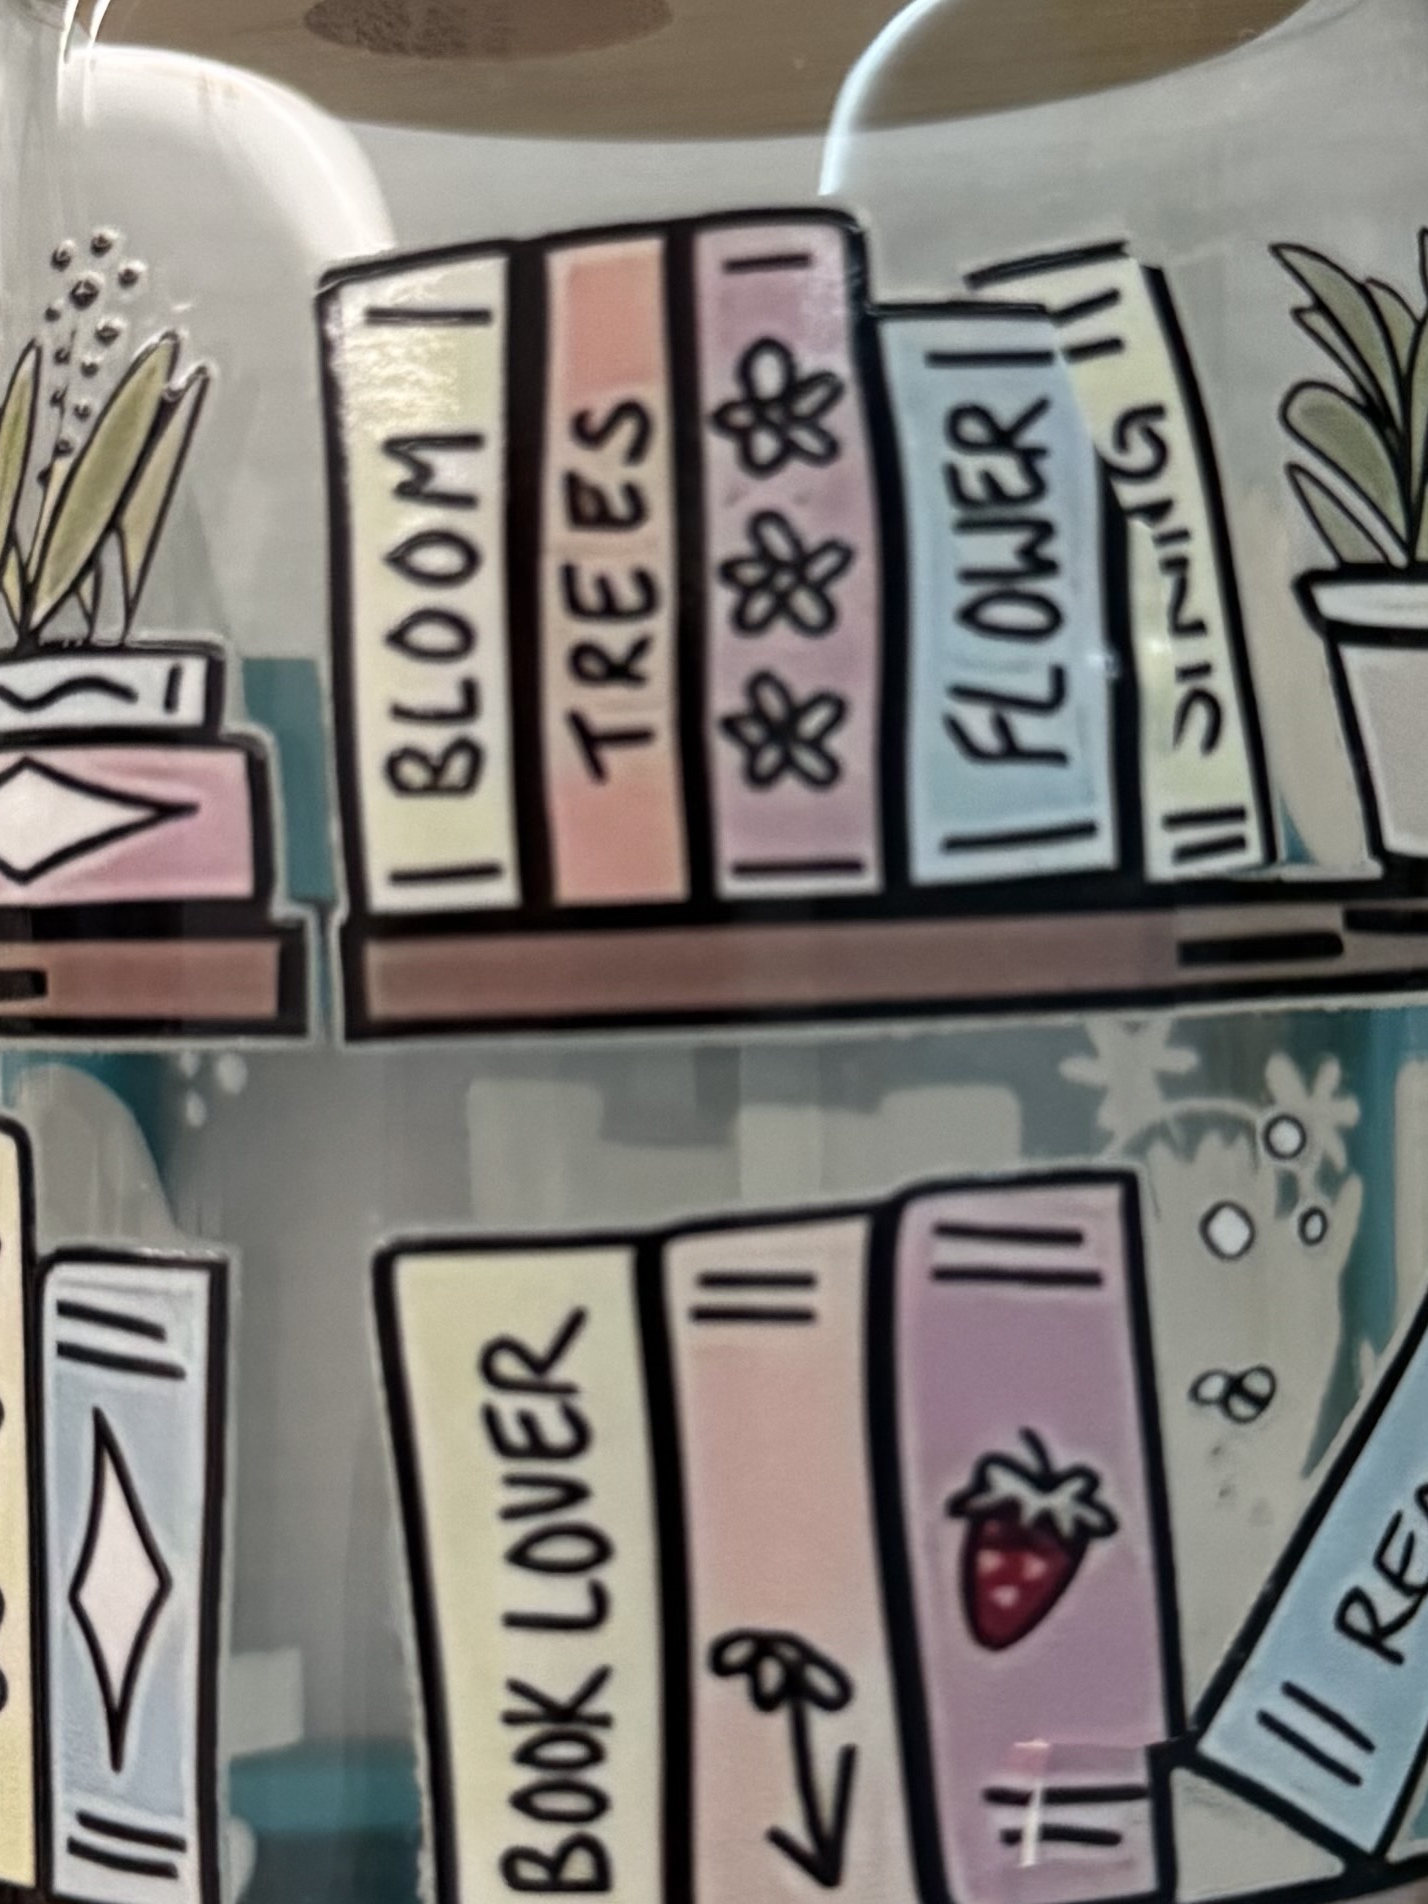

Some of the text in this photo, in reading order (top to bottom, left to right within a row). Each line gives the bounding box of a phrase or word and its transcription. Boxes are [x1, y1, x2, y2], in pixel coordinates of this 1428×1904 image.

[382, 431, 485, 798] BLOOM
[558, 397, 661, 785] TREES
[941, 394, 1072, 769] FLOWER
[477, 1306, 616, 1896] BOOK LOVER
